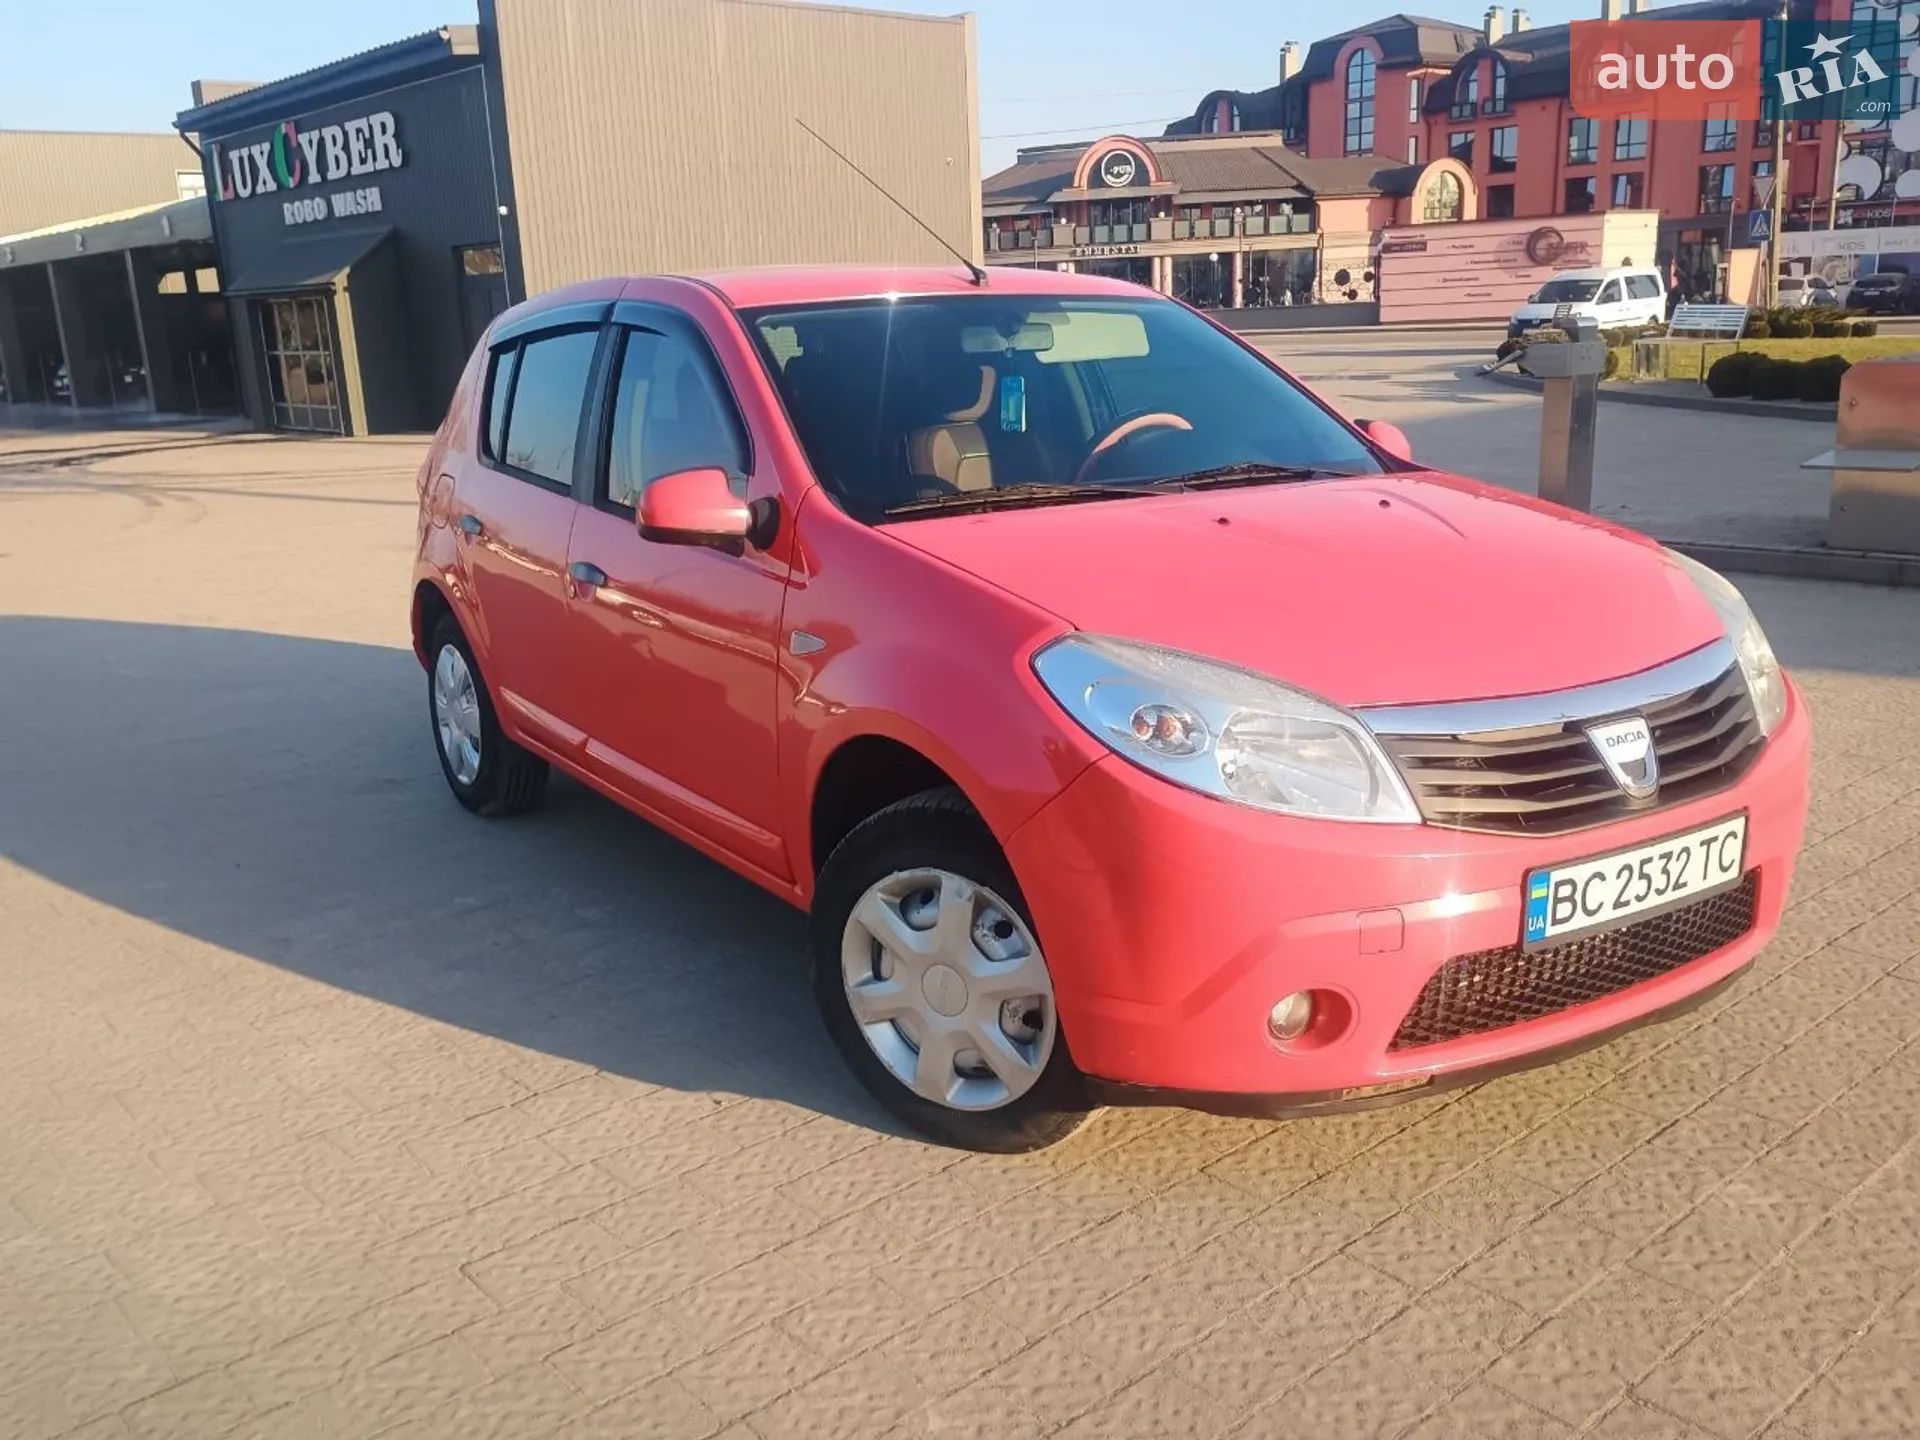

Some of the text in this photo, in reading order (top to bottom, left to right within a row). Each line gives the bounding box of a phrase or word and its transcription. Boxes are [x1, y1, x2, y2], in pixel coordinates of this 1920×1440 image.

[283, 186, 382, 226] ROBO WASH
[1605, 730, 1647, 748] DACIA
[1550, 830, 1738, 926] BC 2532 TC
[1528, 916, 1545, 931] UA
